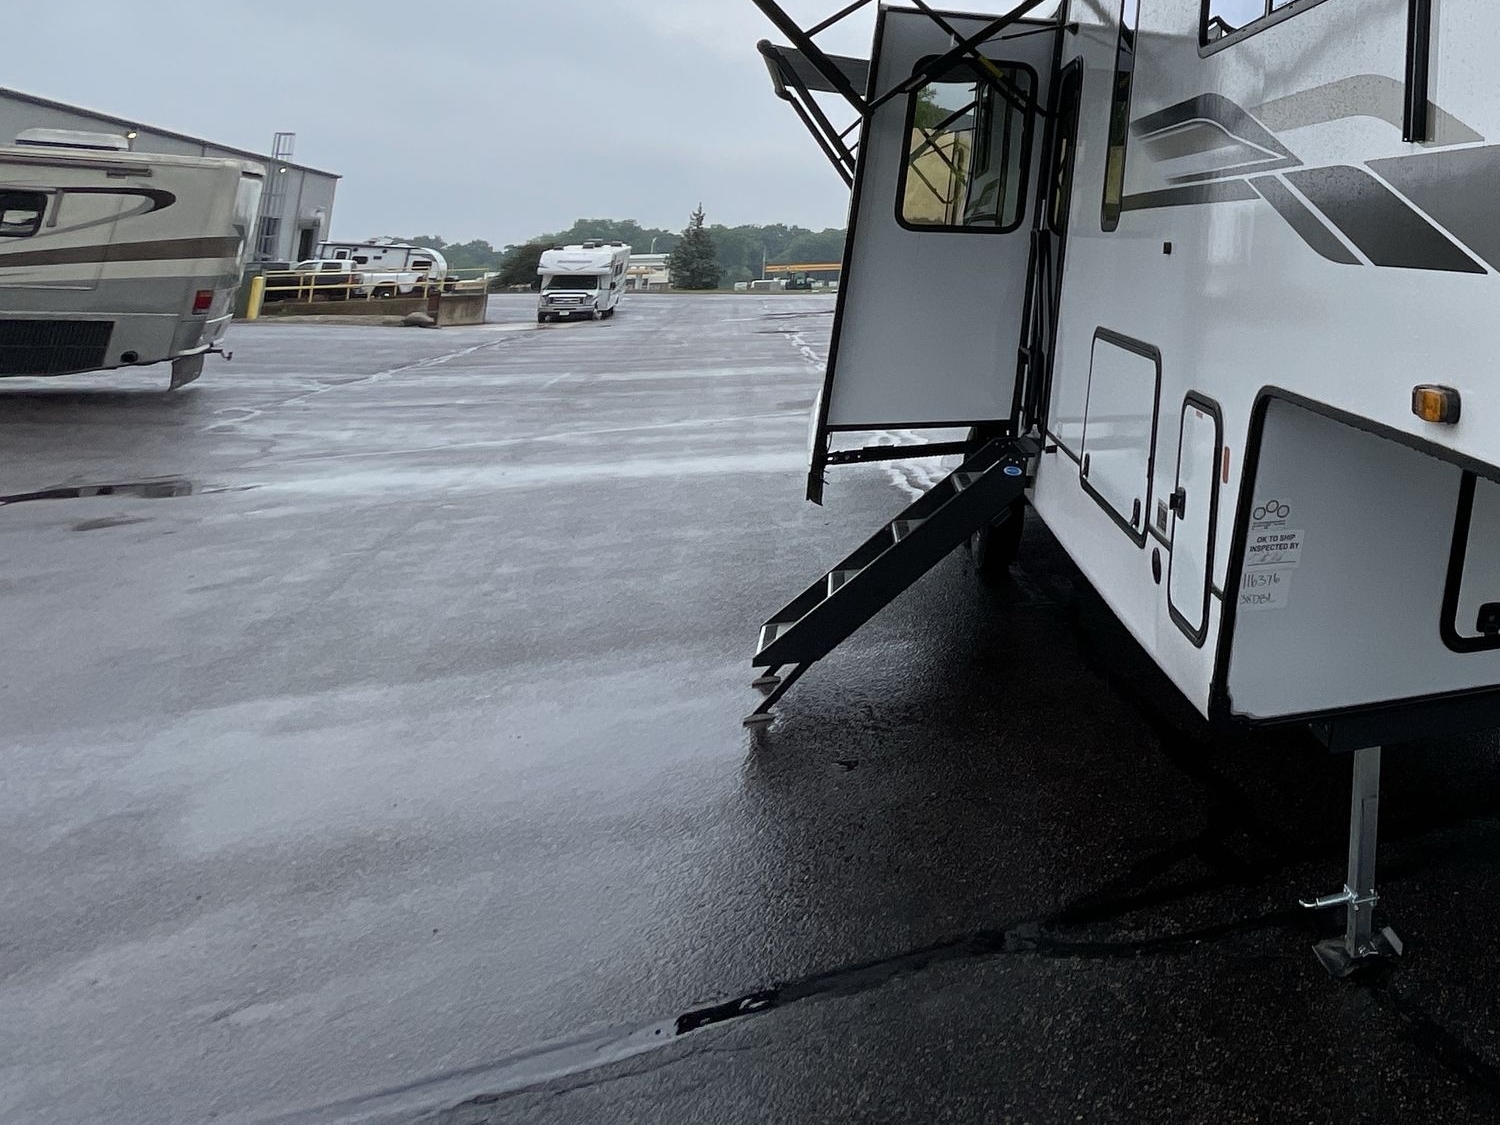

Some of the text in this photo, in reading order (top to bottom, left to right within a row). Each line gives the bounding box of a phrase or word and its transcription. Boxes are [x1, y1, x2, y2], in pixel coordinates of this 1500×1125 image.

[1269, 535, 1279, 543] TO
[1279, 534, 1296, 542] SHIP
[1249, 542, 1300, 553] INSPECTED BY
